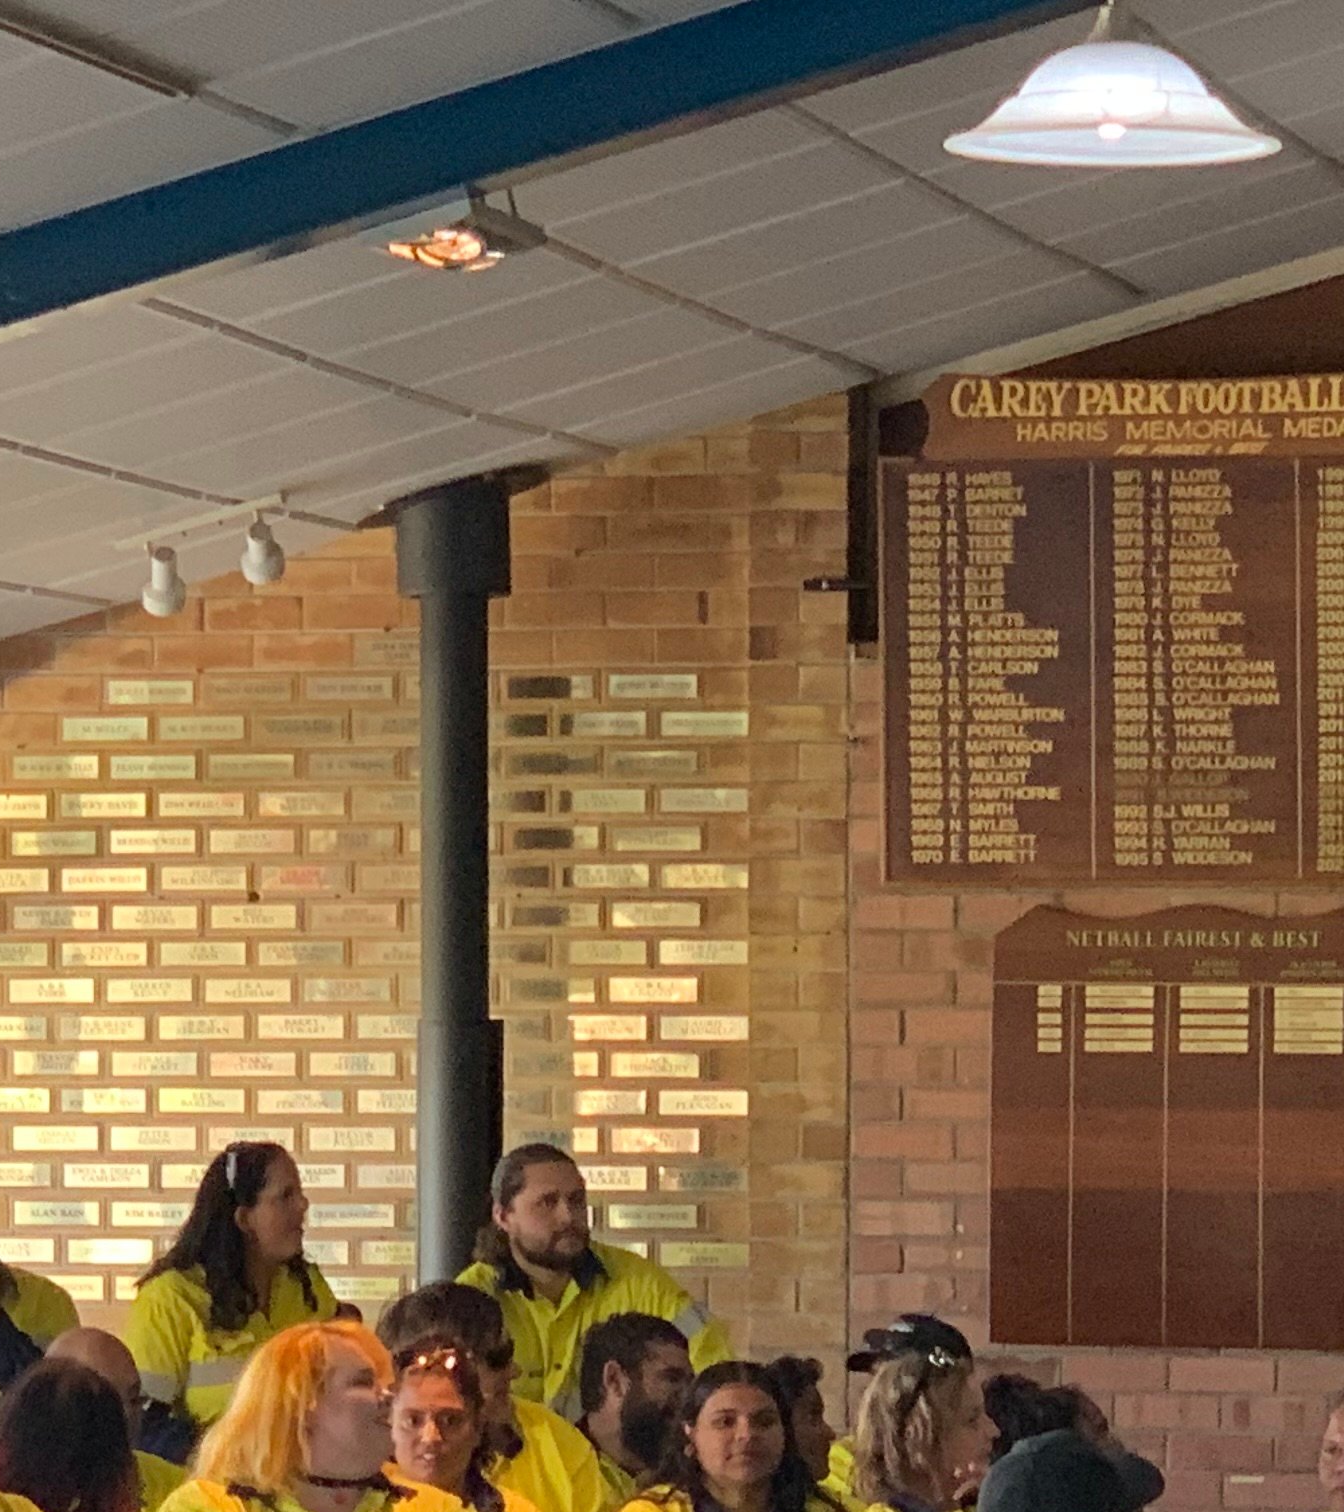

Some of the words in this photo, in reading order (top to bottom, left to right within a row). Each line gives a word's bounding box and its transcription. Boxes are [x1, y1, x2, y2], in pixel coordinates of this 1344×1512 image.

[950, 379, 1075, 418] CAREY
[1077, 379, 1172, 416] PARK
[1017, 420, 1108, 442] HARRIS
[1125, 418, 1272, 440] MEMORIAL
[1181, 804, 1229, 817] WILLIS
[1066, 930, 1154, 948] NETBALL
[1163, 930, 1243, 948] FAIREST
[1249, 931, 1266, 948] &
[1272, 930, 1323, 948] BEST
